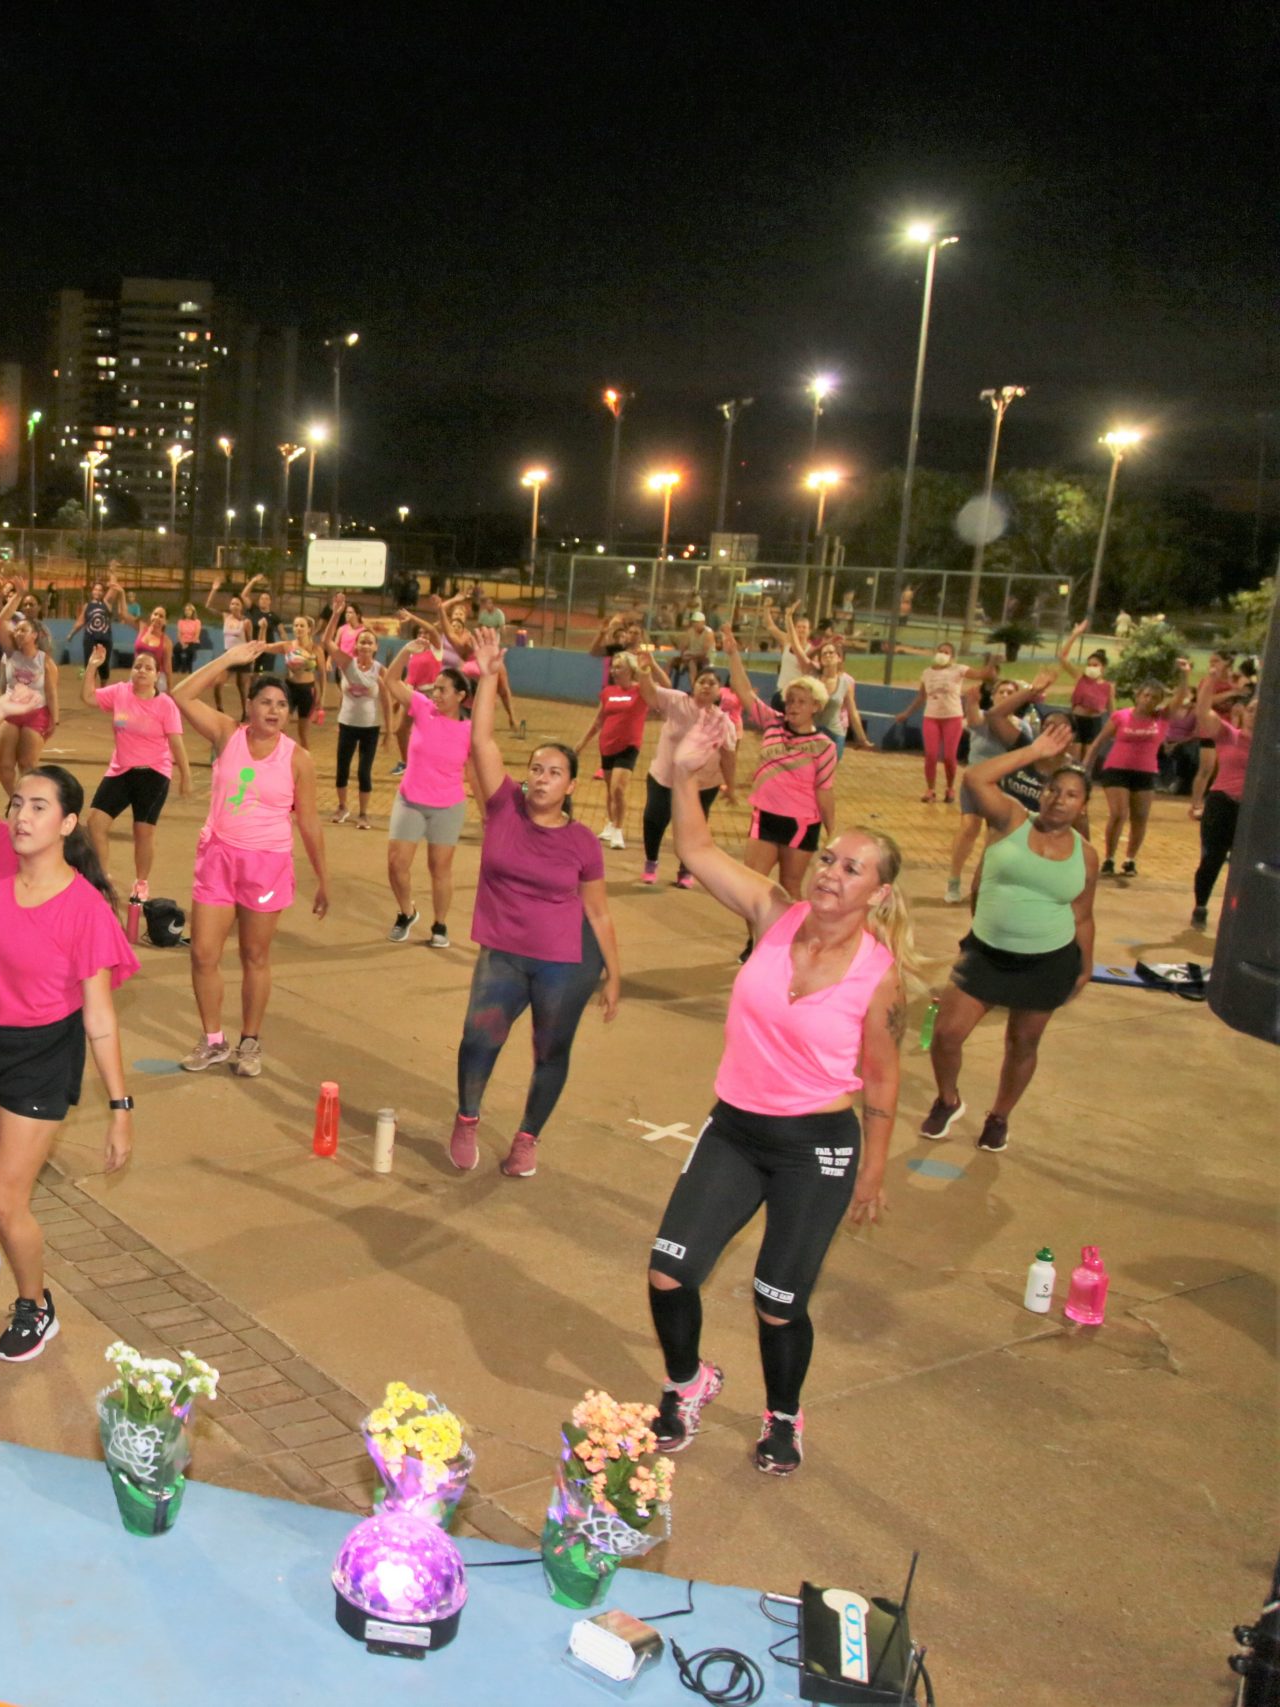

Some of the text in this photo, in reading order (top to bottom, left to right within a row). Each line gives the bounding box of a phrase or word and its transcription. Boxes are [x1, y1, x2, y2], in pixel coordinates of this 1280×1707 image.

[815, 1147, 853, 1156] FAIL WHEN
[818, 1156, 850, 1166] YOU STOP
[821, 1166, 845, 1176] TRYING
